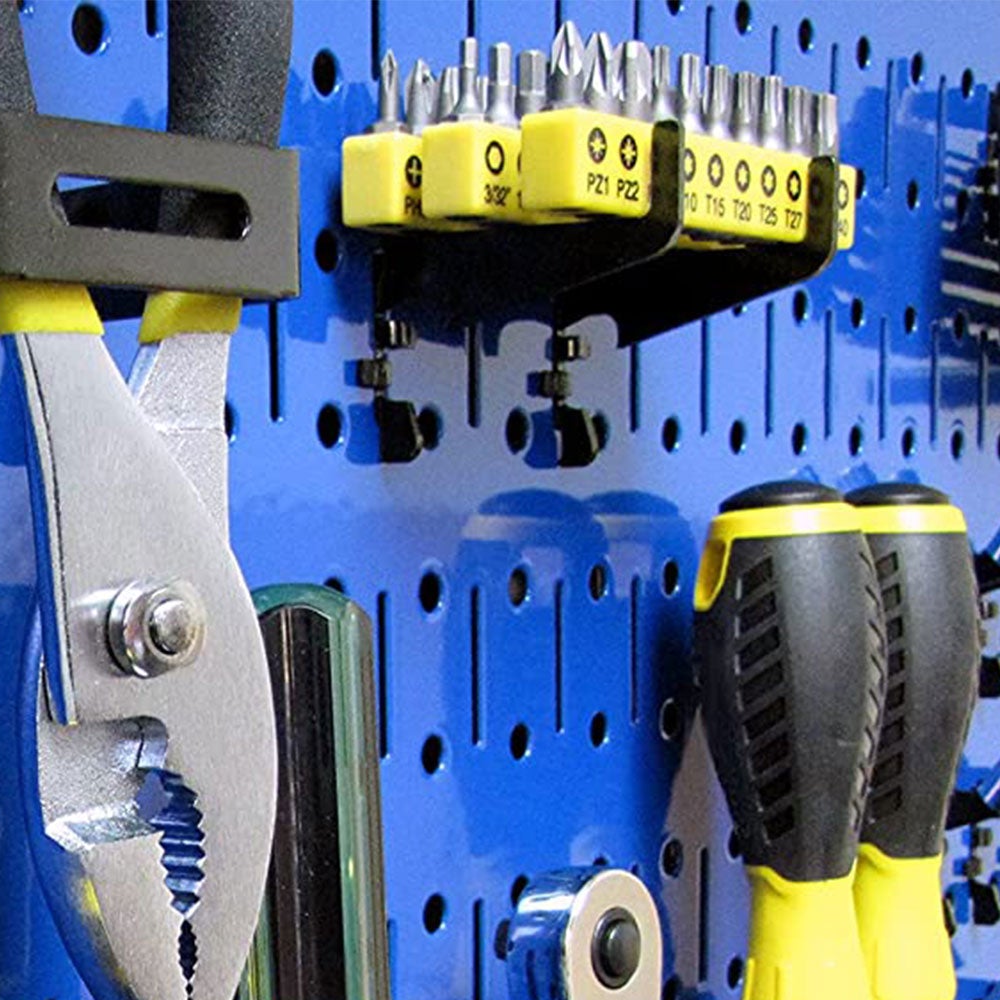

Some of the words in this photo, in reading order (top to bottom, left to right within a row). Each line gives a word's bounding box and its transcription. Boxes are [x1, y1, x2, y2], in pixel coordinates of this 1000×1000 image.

[587, 172, 609, 195] PZ1
[617, 178, 639, 201] PZ2
[706, 193, 725, 217] T15
[733, 198, 751, 221] T20
[758, 203, 778, 226] T25
[785, 208, 802, 229] T27
